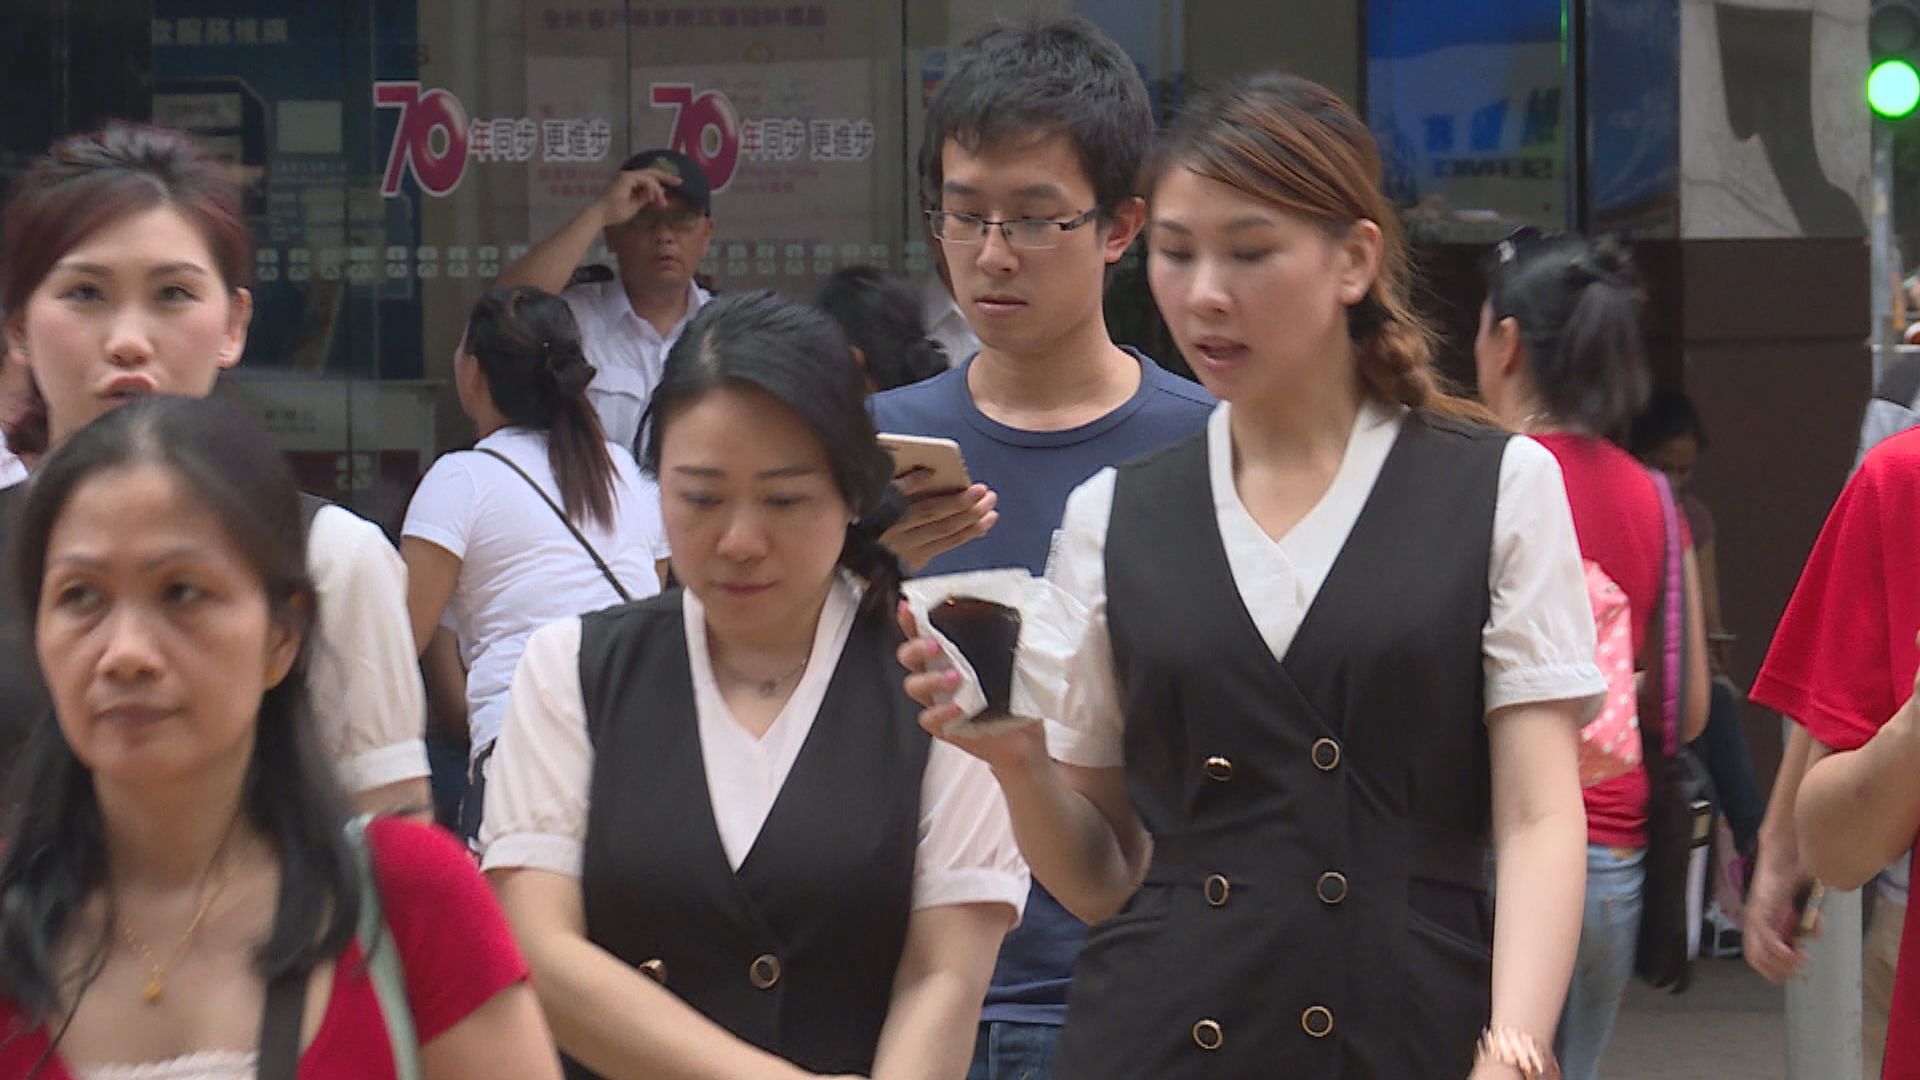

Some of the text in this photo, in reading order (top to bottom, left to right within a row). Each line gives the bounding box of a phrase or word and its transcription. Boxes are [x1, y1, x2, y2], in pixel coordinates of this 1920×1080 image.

[543, 119, 611, 164] 更進步
[810, 119, 876, 162] 更進步
